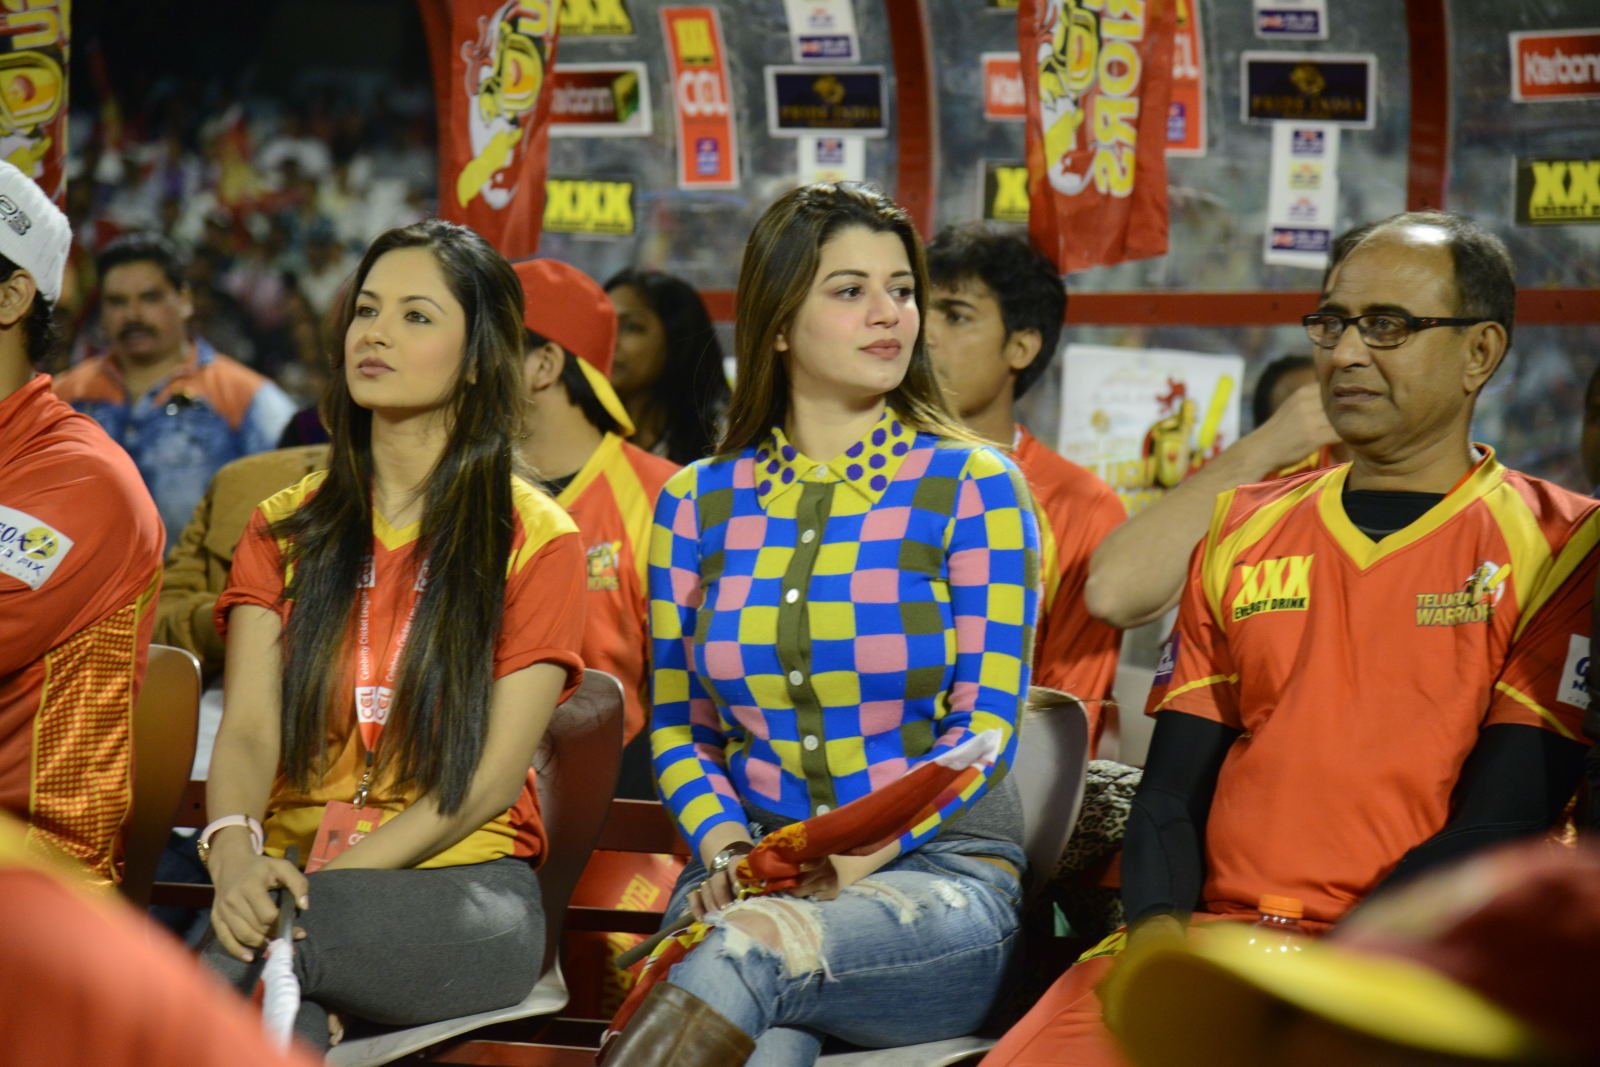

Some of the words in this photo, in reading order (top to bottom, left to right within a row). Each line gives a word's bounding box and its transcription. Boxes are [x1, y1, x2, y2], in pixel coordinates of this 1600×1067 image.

[1522, 47, 1600, 87] Karbon
[543, 180, 633, 222] XXX
[1232, 553, 1315, 609] XXX
[1271, 597, 1306, 610] DRINK
[359, 619, 369, 644] Cricket
[359, 647, 370, 680] Celebrity
[360, 689, 375, 719] CCL
